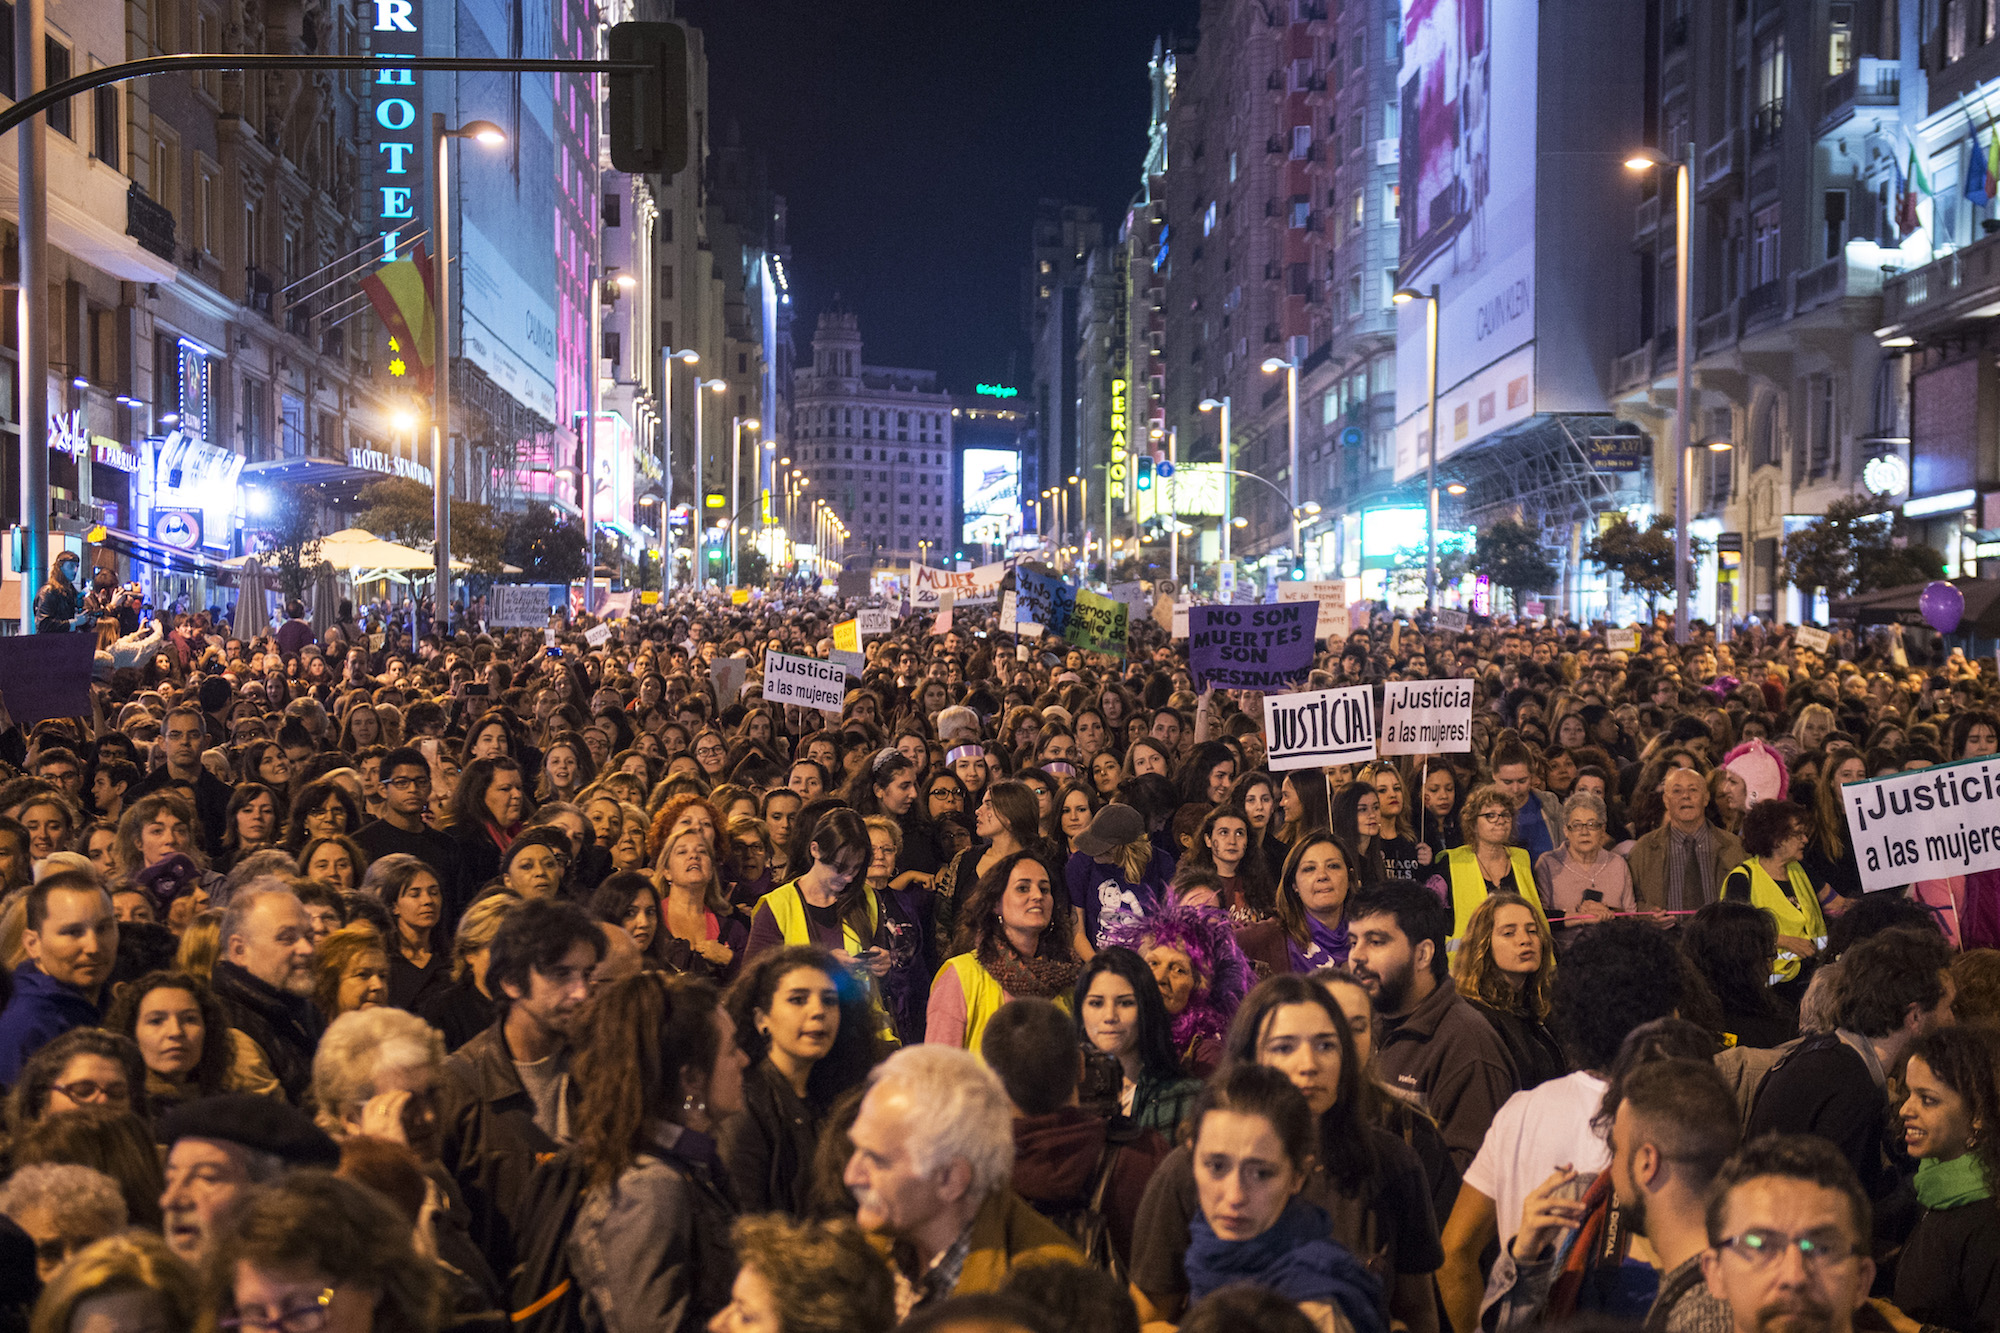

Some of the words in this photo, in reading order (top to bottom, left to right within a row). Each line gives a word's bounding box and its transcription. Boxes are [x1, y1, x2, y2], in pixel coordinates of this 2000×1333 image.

[352, 447, 392, 474] HOTEL
[956, 587, 980, 600] POR
[1207, 610, 1242, 626] NO
[1252, 607, 1299, 626] SON
[1194, 625, 1302, 649] MUERTES
[1220, 646, 1268, 663] SON
[769, 656, 844, 683] ¡Justicia
[768, 680, 774, 692] a
[777, 678, 793, 696] las
[796, 685, 842, 706] mujeres!
[1390, 686, 1470, 715] ¡Justicia
[1387, 726, 1395, 743] a
[1399, 720, 1416, 743] las
[1420, 719, 1470, 747] mujeres!
[1866, 846, 1881, 872] a
[1884, 835, 1920, 868] las
[1604, 1211, 1620, 1258] DIGITAL
